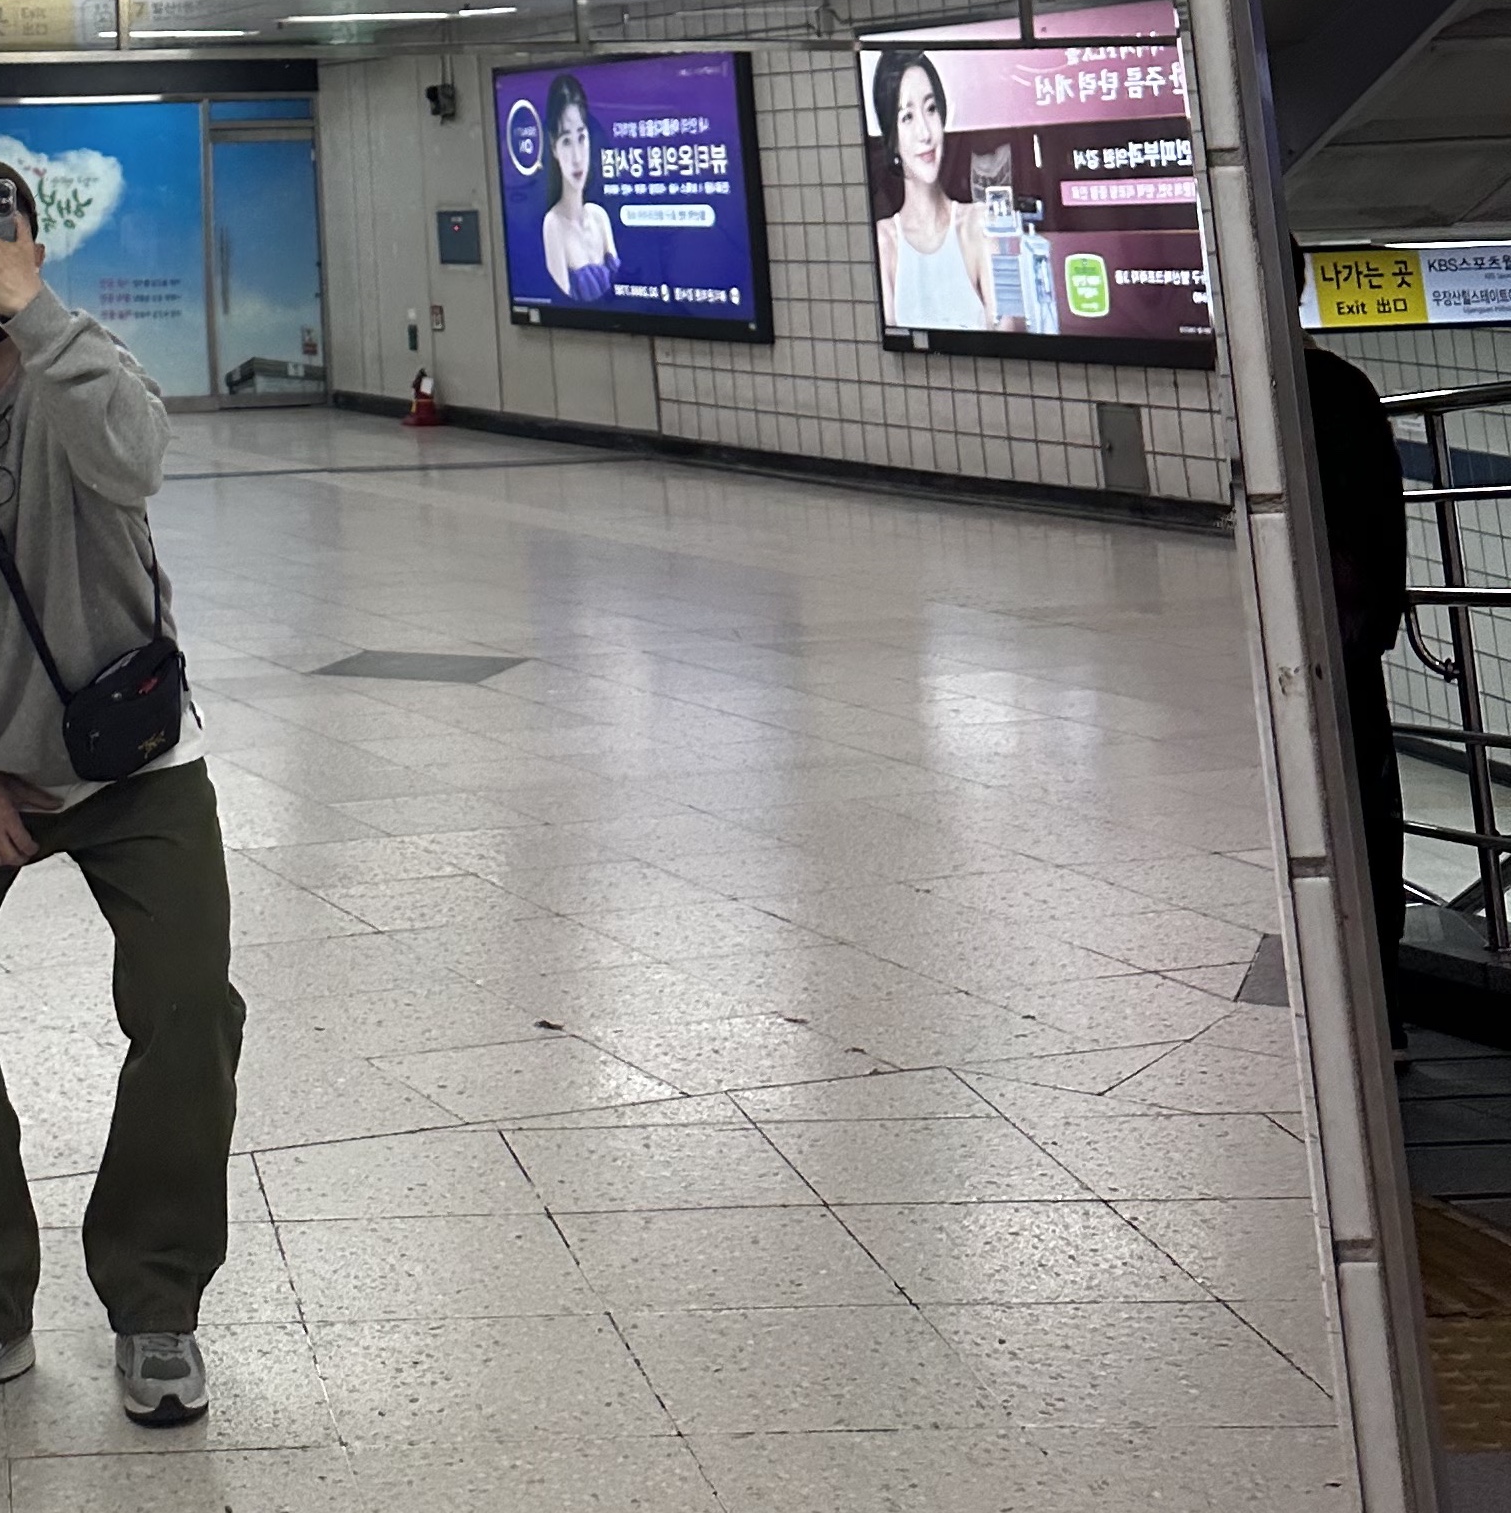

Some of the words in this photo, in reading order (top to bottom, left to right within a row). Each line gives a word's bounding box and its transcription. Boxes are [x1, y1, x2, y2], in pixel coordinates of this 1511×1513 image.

[1320, 260, 1384, 290] 나가는
[1391, 259, 1415, 289] 곳
[1336, 299, 1368, 316] Exit
[1376, 297, 1408, 315] 出口
[1432, 288, 1511, 307] 우장산힐스테이트
